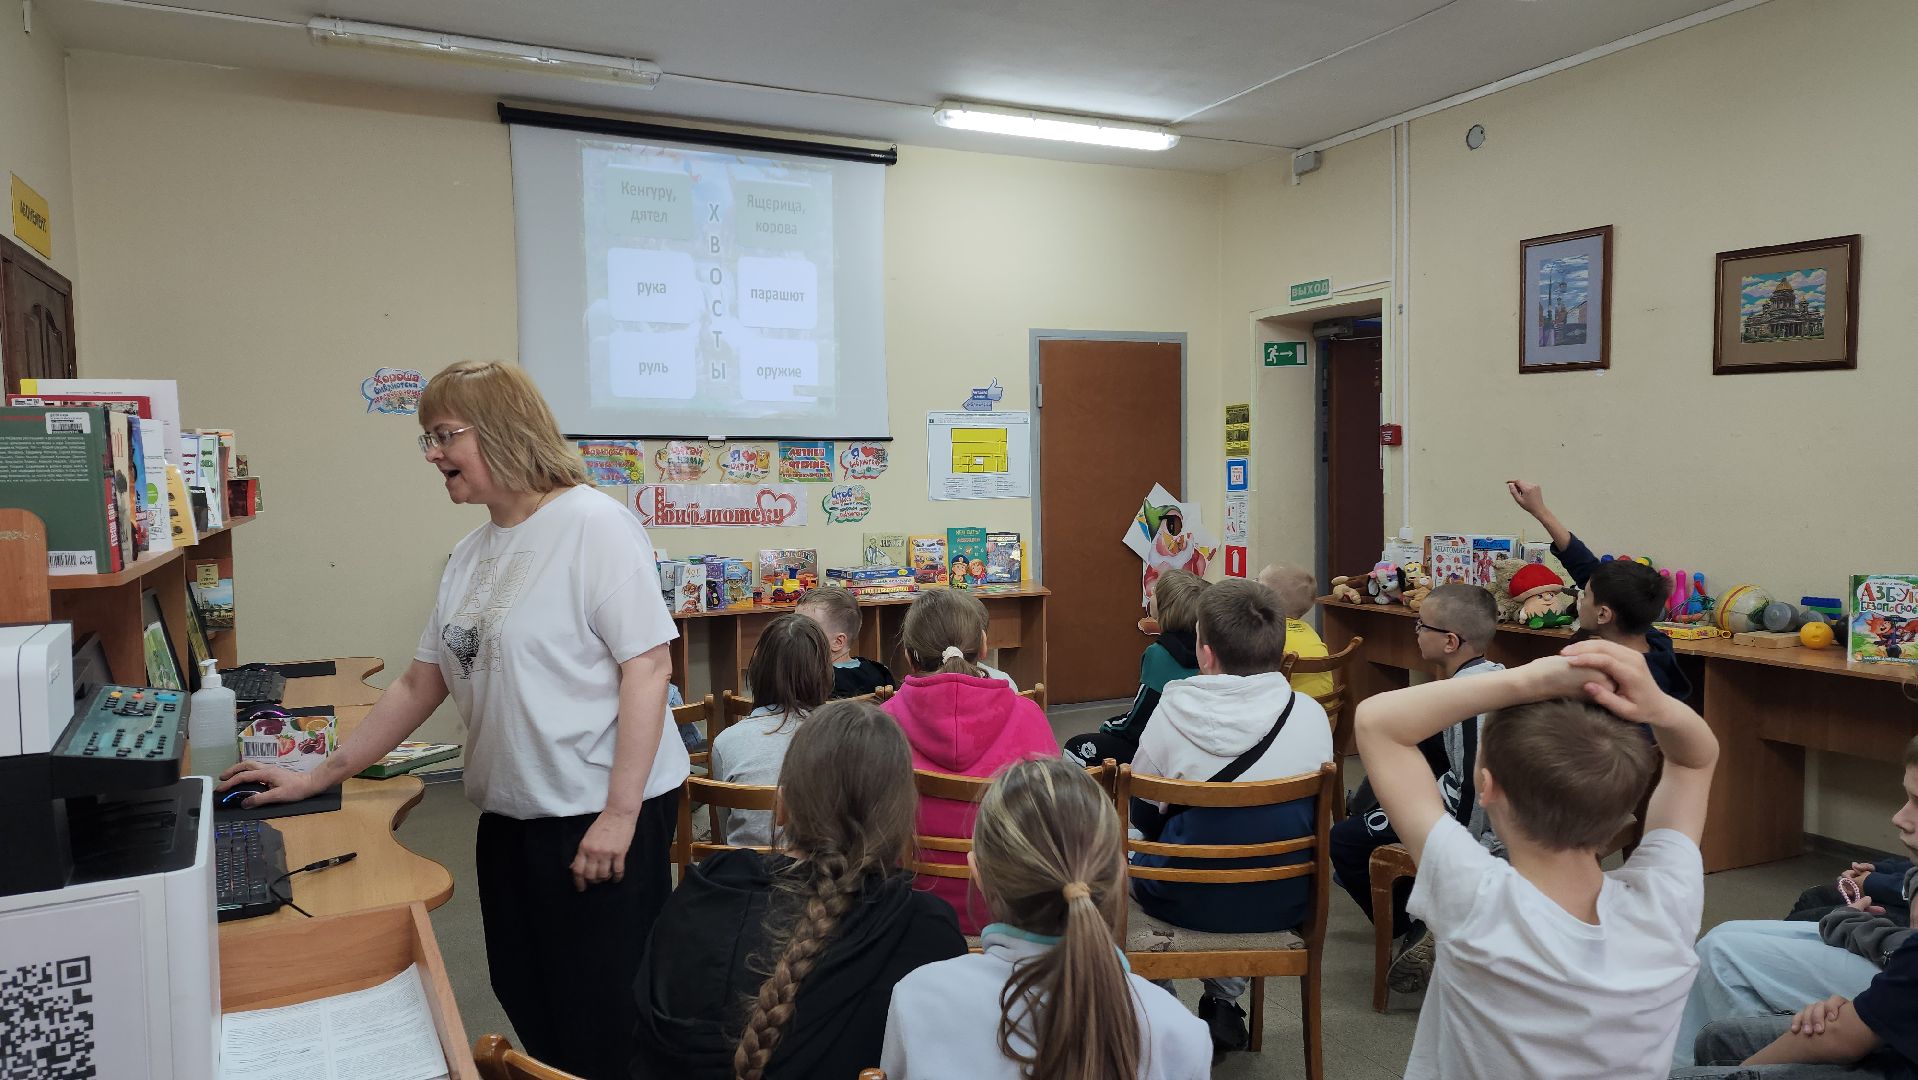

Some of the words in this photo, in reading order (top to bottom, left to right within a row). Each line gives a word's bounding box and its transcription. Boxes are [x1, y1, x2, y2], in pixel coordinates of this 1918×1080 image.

[620, 181, 677, 203] Кенгуру,
[746, 194, 806, 214] Ящерица,
[630, 208, 668, 224] дятел
[755, 221, 798, 236] корова
[637, 281, 667, 296] рука
[750, 288, 805, 303] парашют
[1291, 282, 1328, 297] ВЫХОД
[638, 360, 669, 376] руль
[756, 366, 802, 379] оружие
